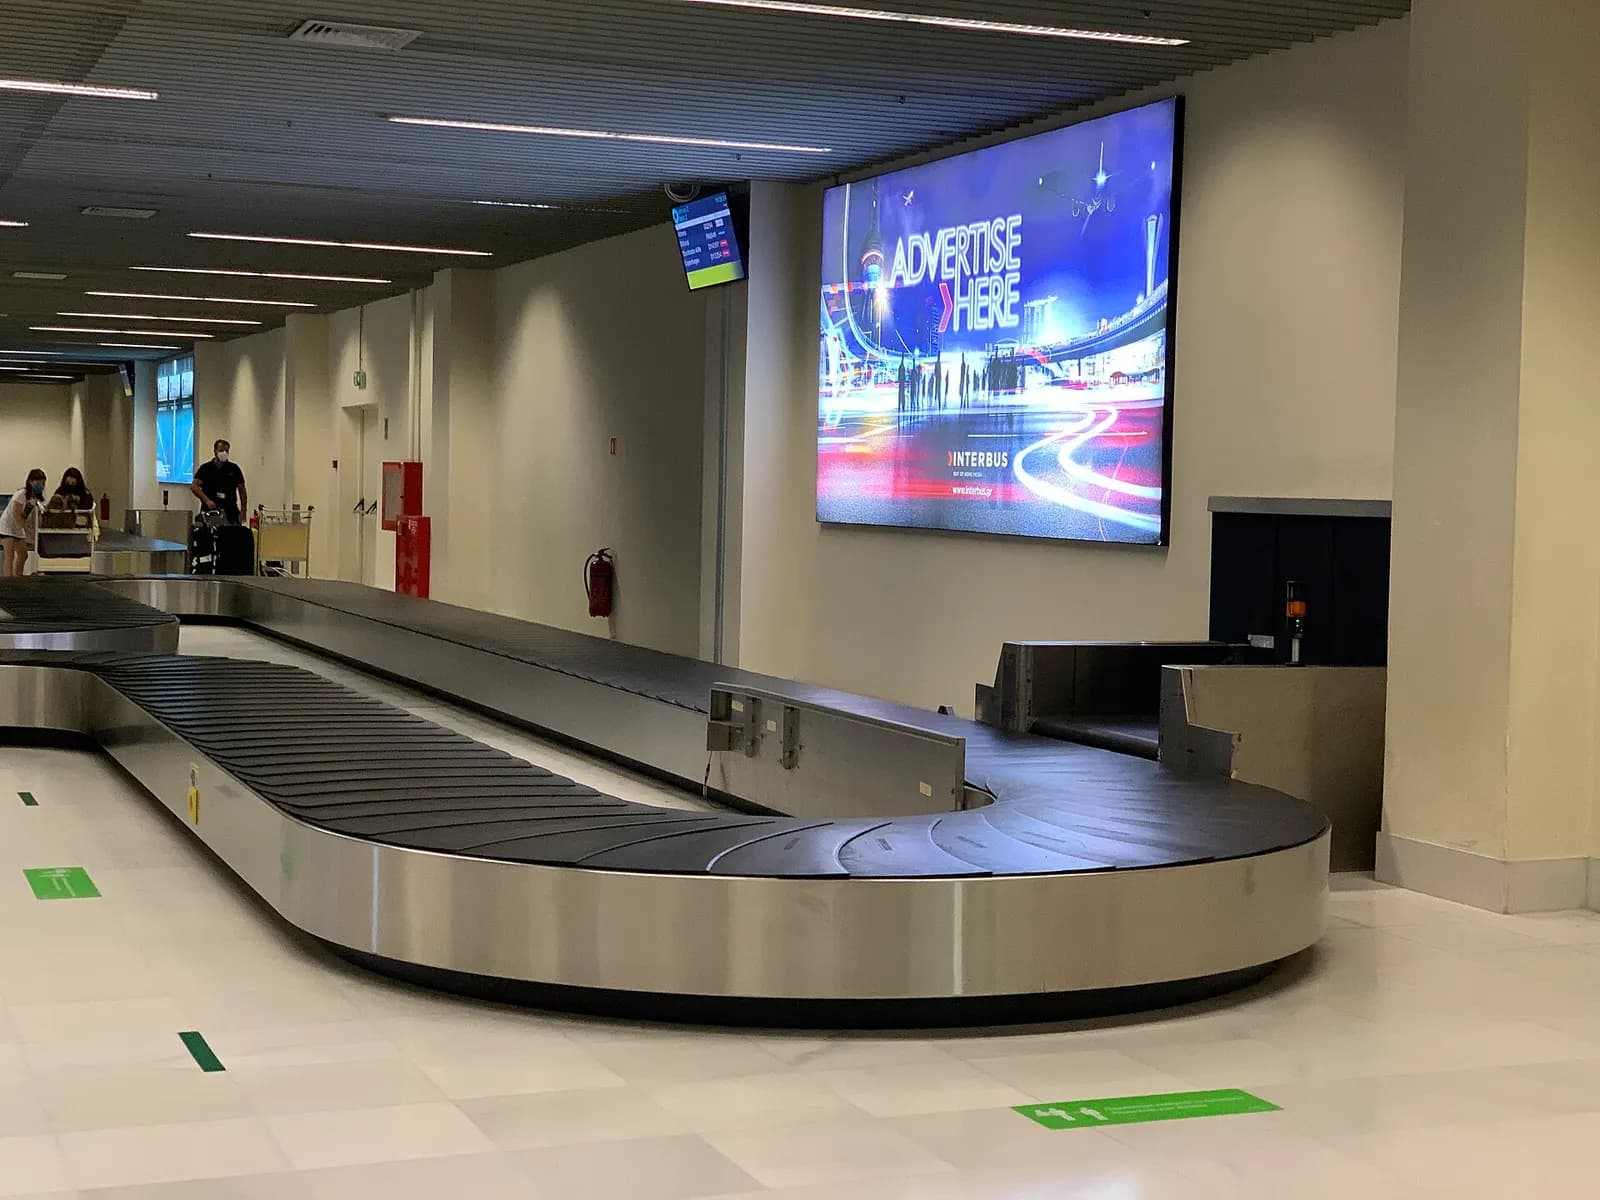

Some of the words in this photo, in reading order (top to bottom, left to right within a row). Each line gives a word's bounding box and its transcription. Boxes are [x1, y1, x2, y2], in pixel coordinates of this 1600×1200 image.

[890, 214, 1022, 288] ADVERTISE
[953, 271, 1020, 332] HERE
[953, 451, 1008, 468] INTERBUS
[952, 485, 993, 498] www.interbus.gr
